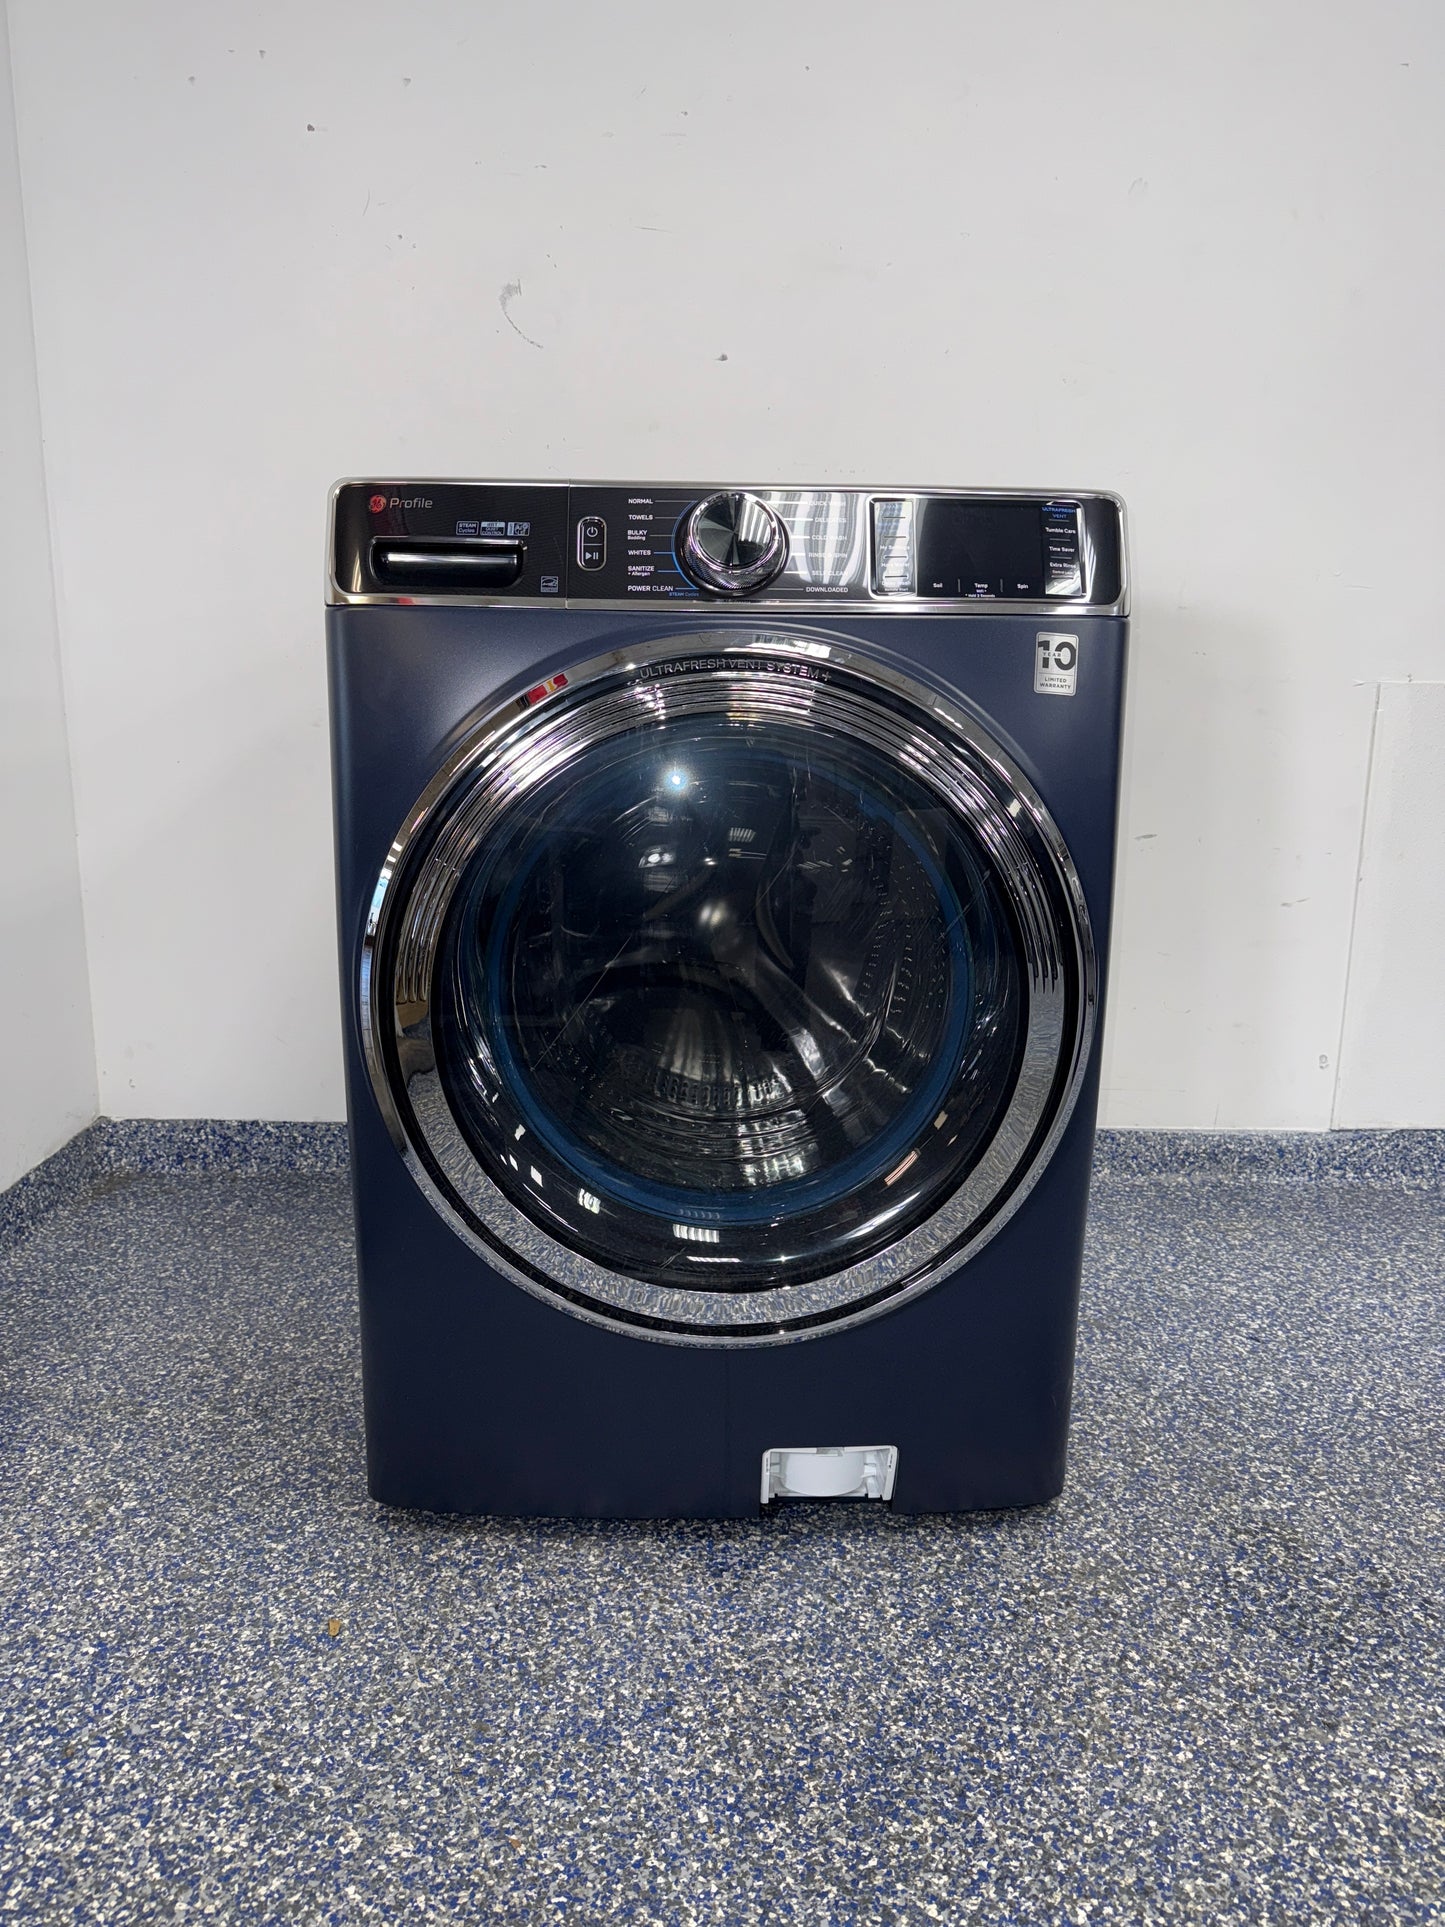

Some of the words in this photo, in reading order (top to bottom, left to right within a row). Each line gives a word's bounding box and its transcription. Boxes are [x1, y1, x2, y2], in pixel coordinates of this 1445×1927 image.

[390, 497, 433, 509] Profile
[1038, 640, 1076, 671] 10
[640, 659, 725, 678] ULTRAFRESH
[728, 659, 763, 669] VENT
